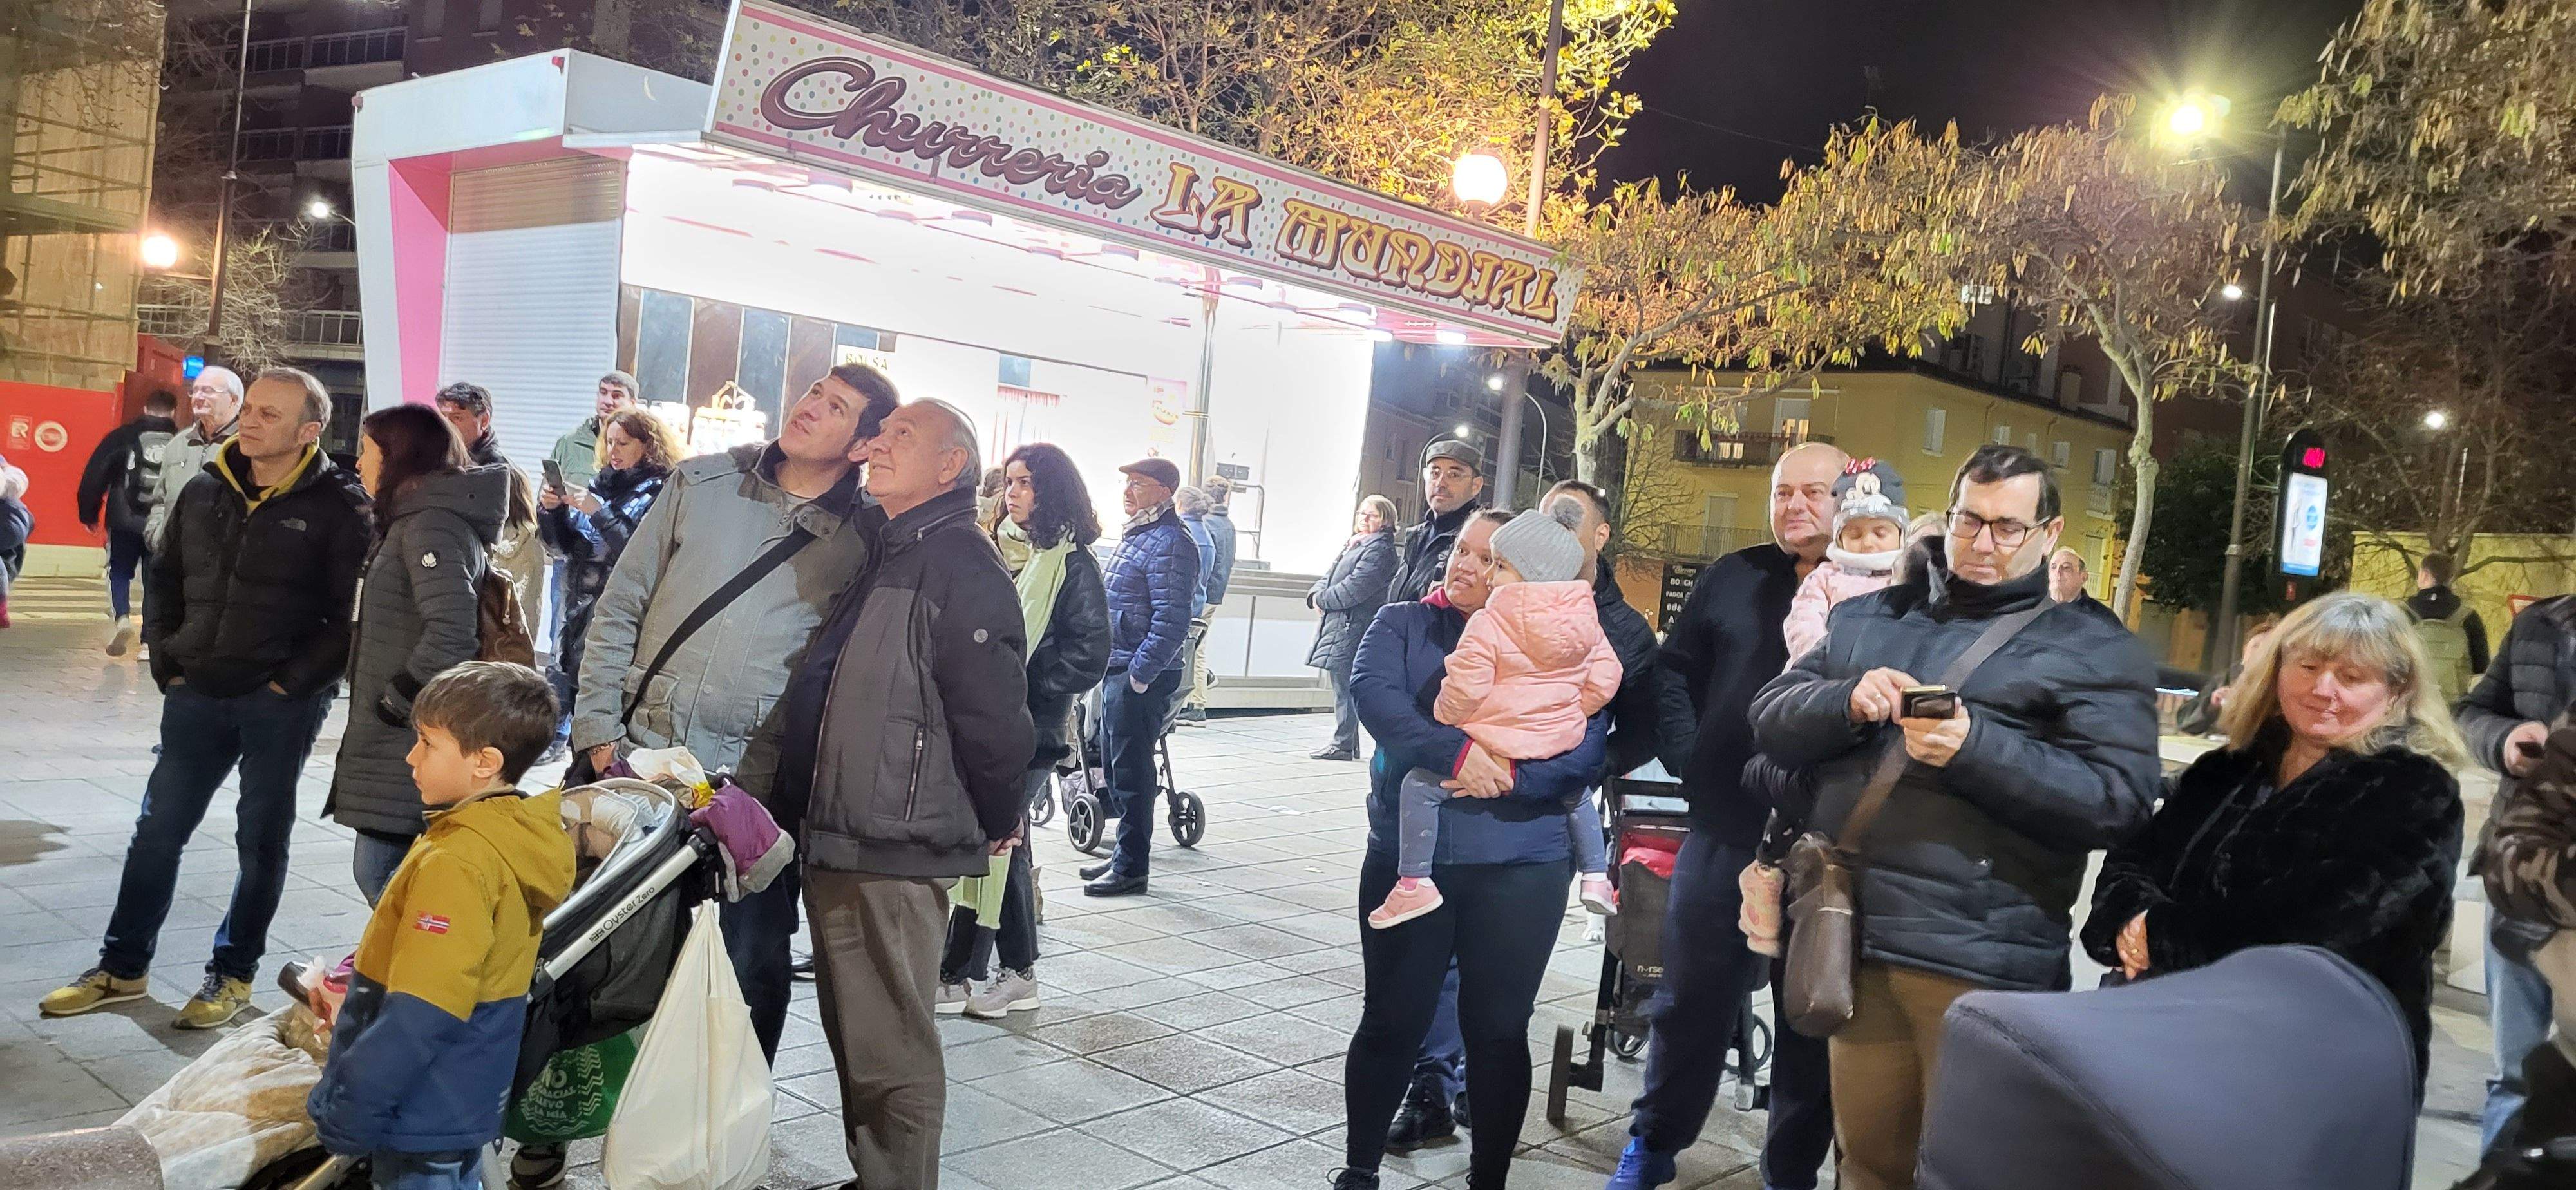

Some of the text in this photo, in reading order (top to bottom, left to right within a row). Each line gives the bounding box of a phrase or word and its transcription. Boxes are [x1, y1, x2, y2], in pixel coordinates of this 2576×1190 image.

[1150, 162, 1262, 249] LA
[1274, 198, 1558, 323] MUNDIAL
[603, 887, 655, 930] Oyster Zero
